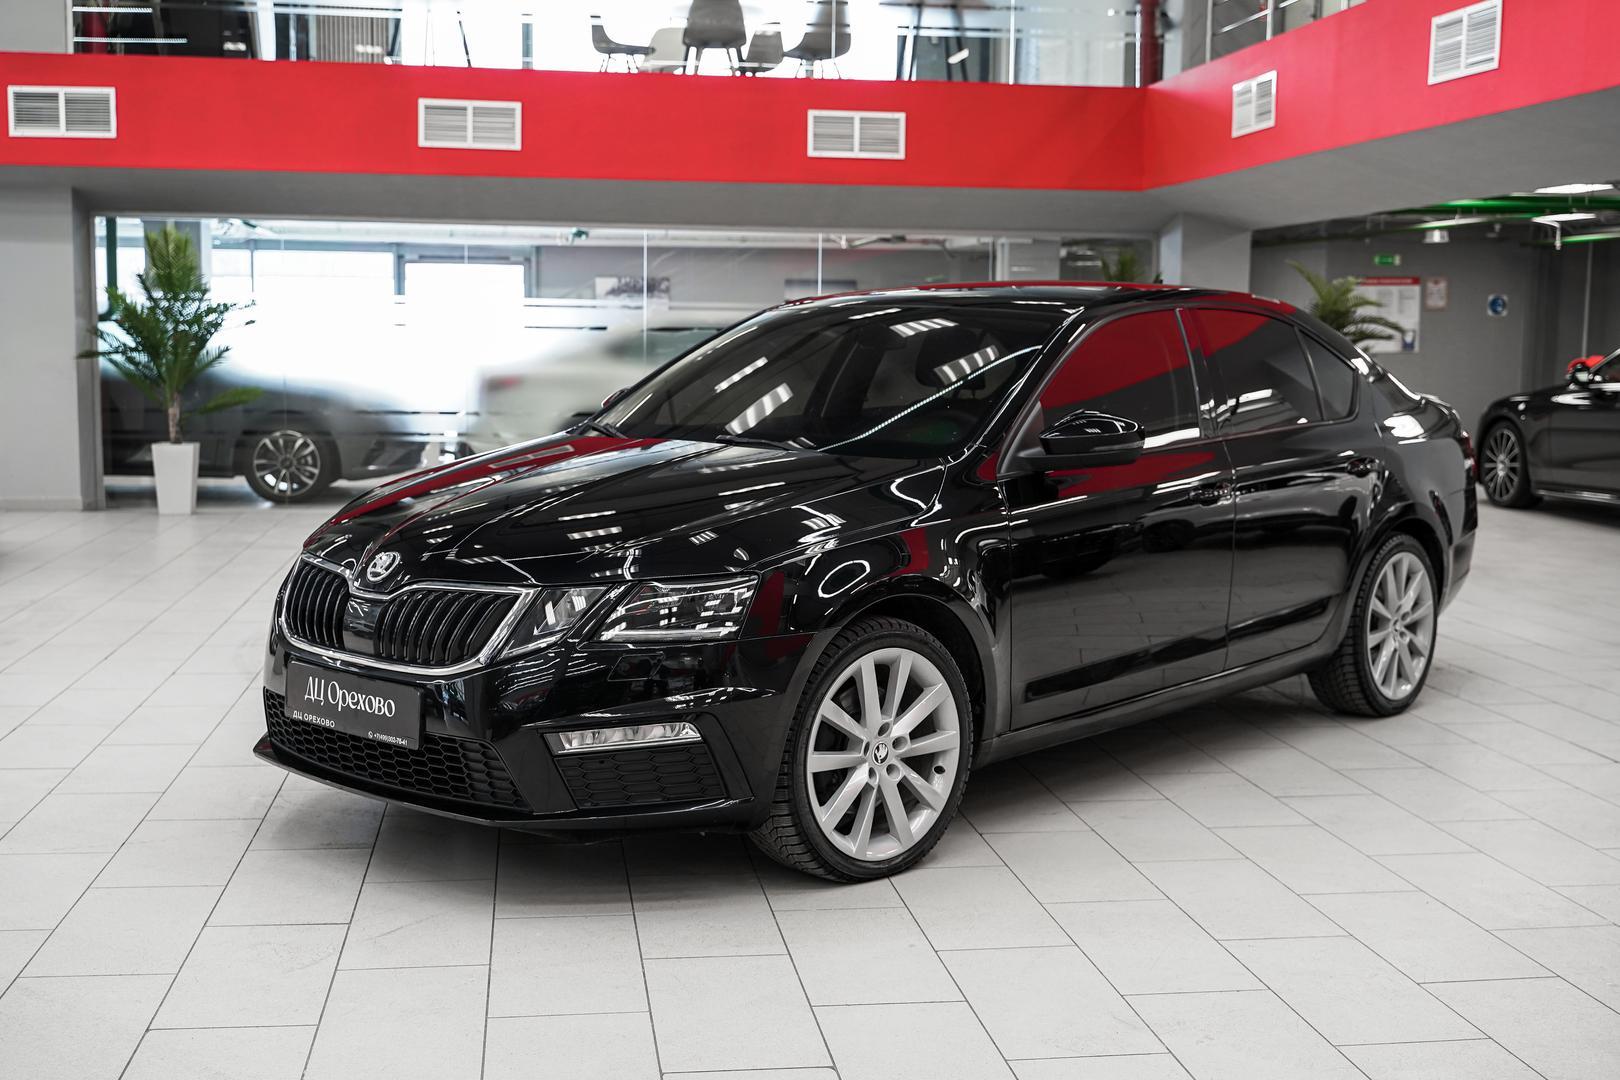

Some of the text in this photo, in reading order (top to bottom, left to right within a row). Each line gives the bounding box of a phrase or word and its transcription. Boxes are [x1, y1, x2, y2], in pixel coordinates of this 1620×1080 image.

[304, 676, 396, 717] ДЦ Орехово
[293, 710, 336, 728] ДЦ ОРЕХОВО
